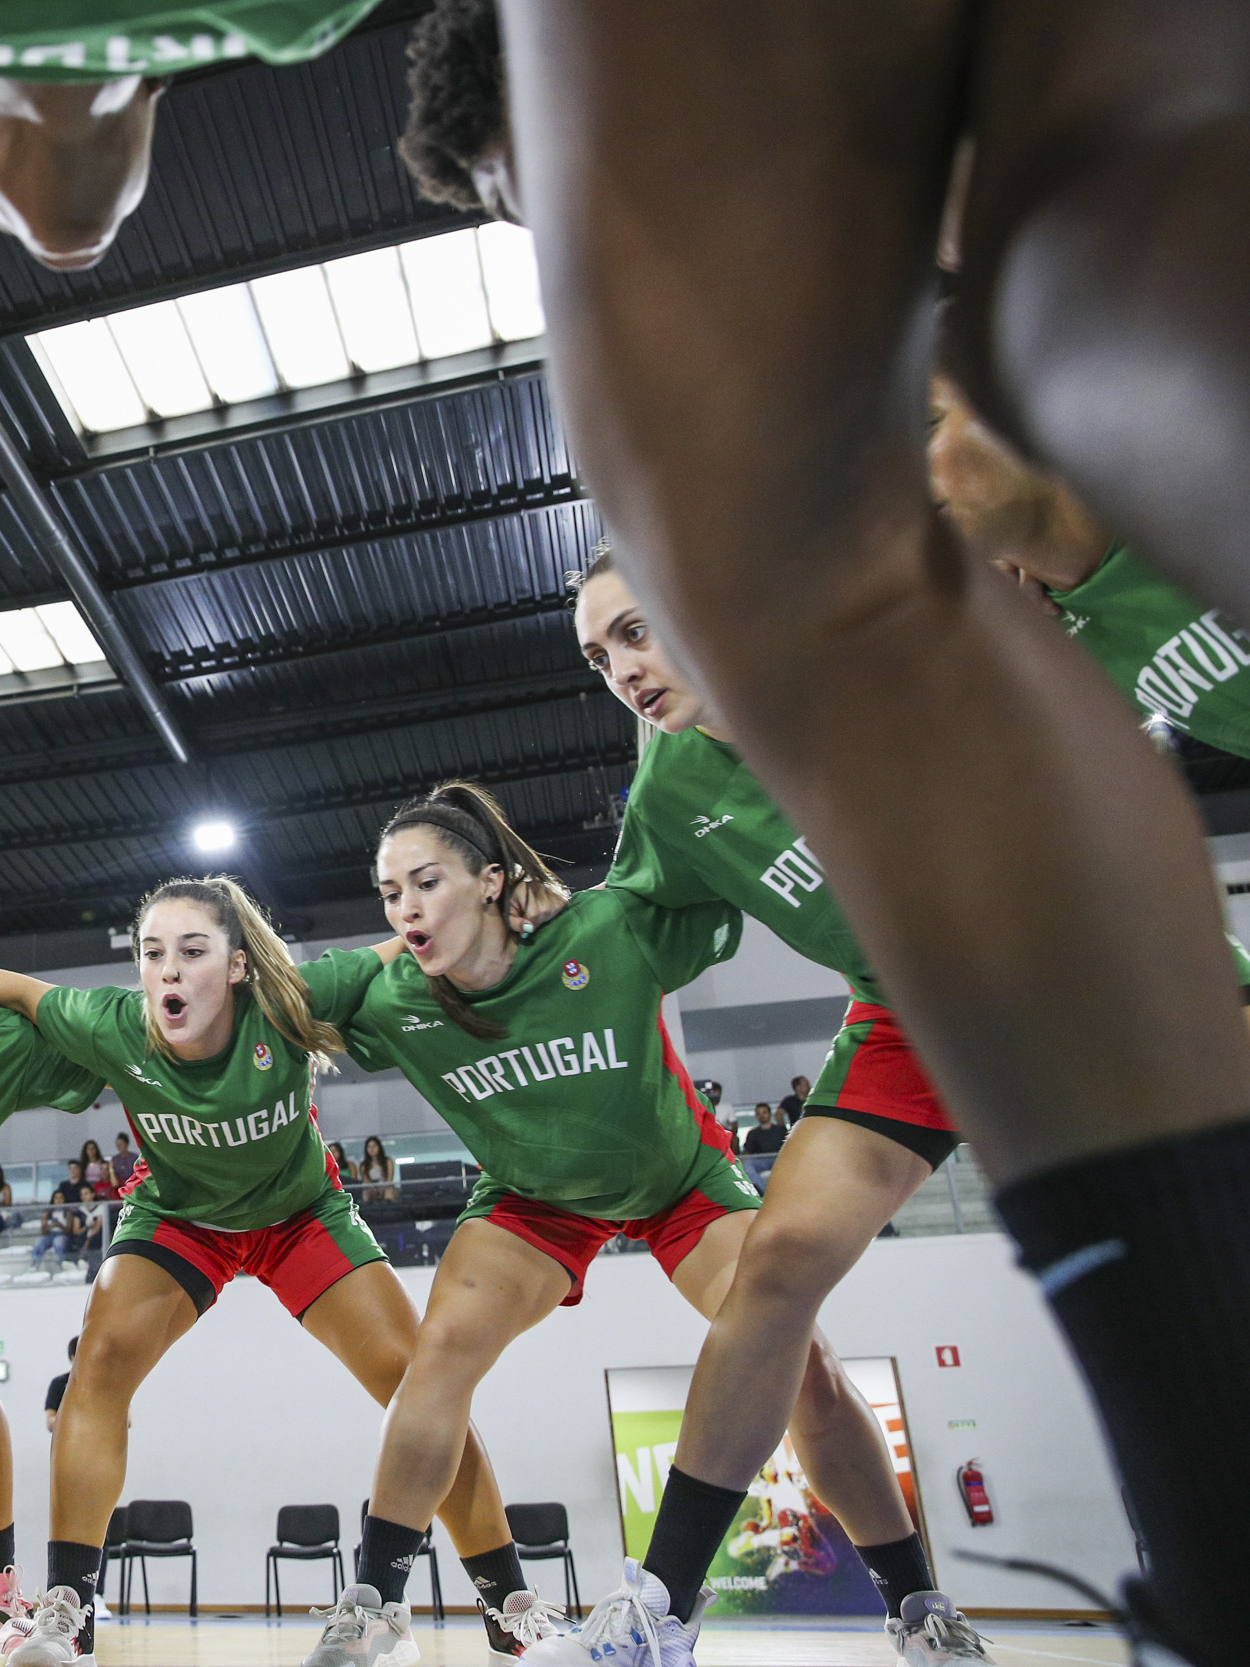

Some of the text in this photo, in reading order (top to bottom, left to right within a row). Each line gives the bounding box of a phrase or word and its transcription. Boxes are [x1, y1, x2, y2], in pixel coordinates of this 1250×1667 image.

[401, 1019, 445, 1032] DHIKA
[440, 1028, 629, 1104] PORTUGAL
[137, 1091, 300, 1148] PORTUGAL
[710, 1575, 768, 1591] WELCOME
